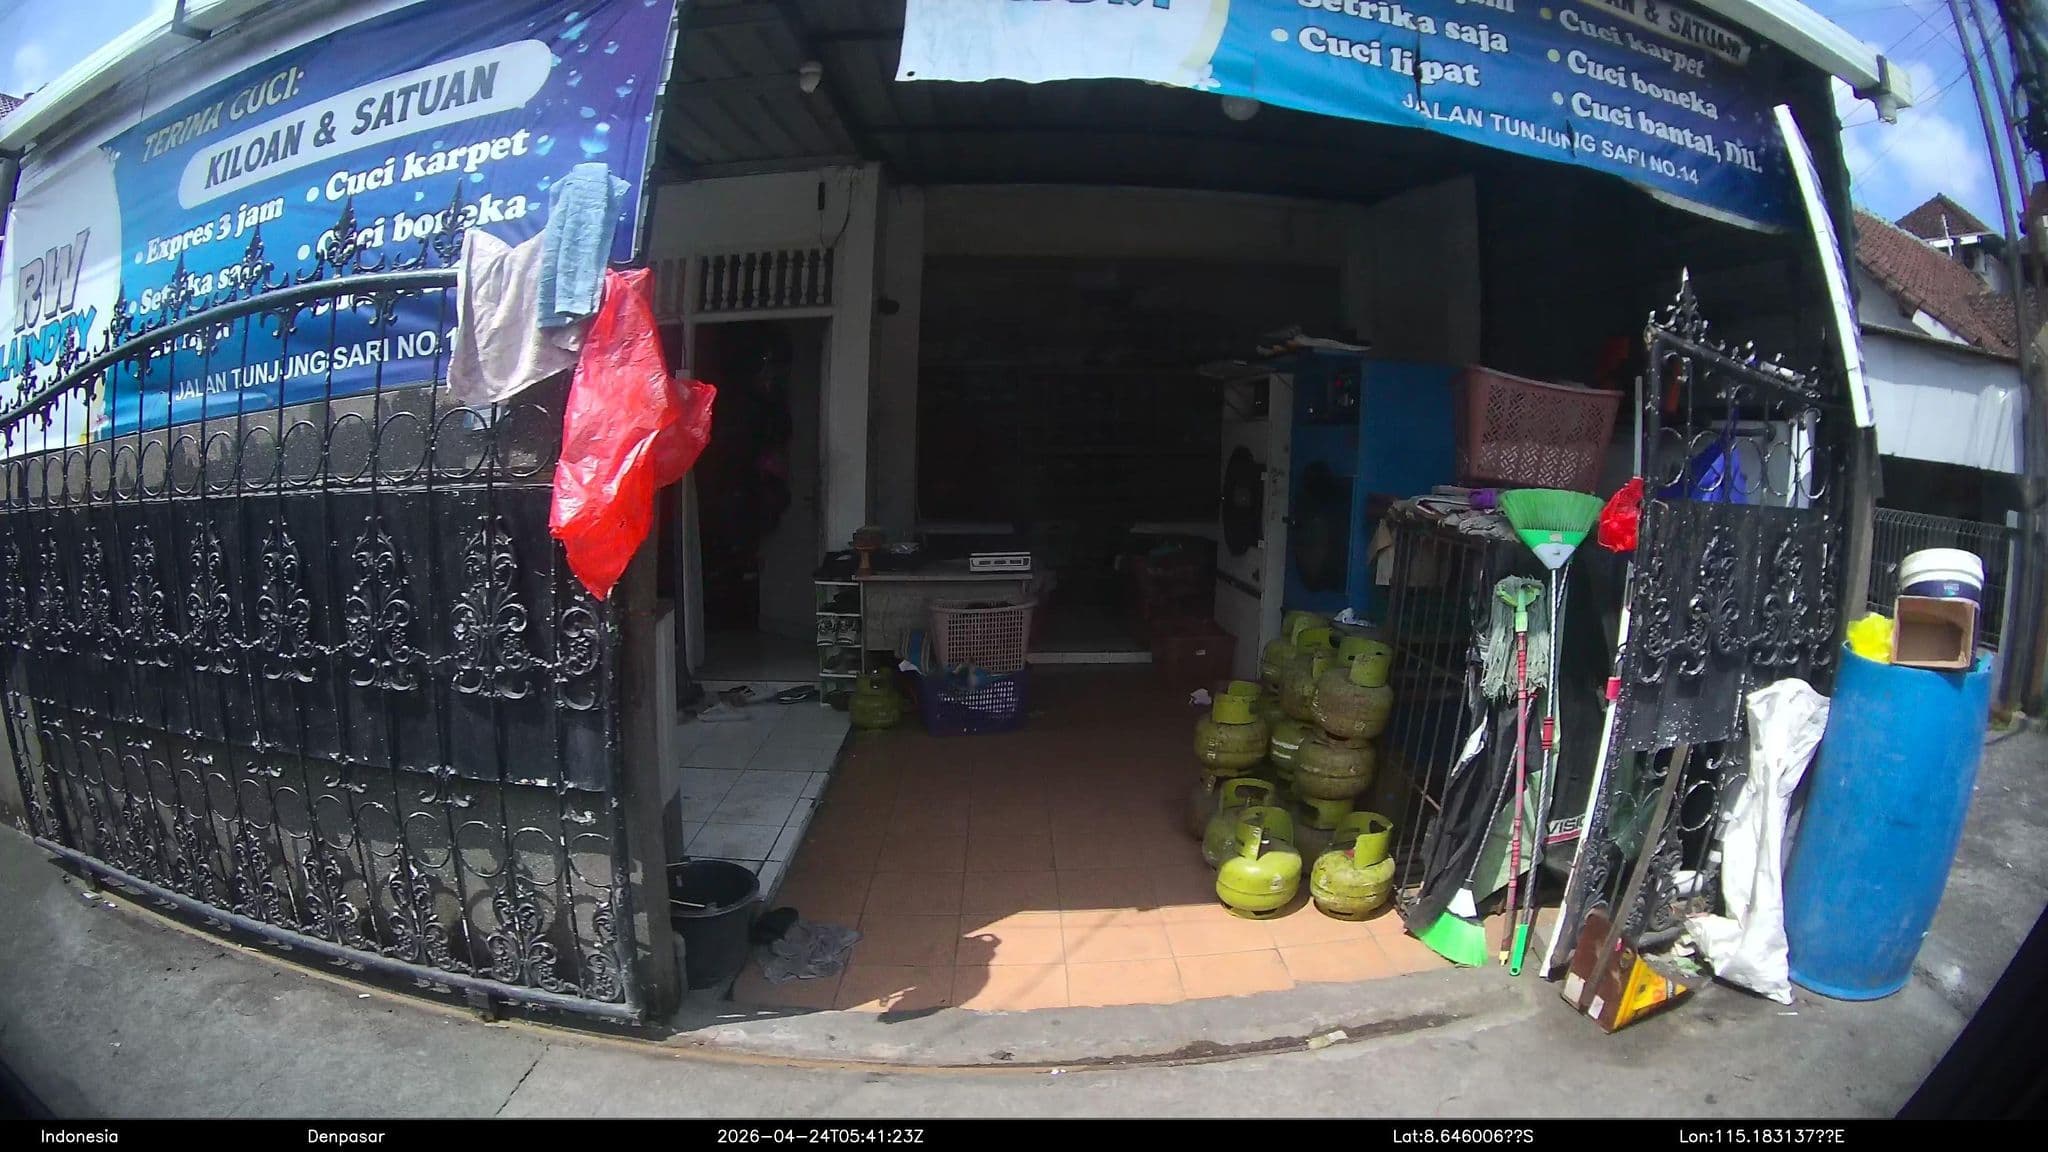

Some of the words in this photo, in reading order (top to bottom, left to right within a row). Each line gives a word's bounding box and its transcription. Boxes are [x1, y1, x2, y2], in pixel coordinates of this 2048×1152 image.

[1298, 26, 1383, 67] Cuci
[1389, 47, 1481, 87] lipat
[1445, 21, 1509, 52] saja
[1559, 8, 1625, 47] Cuci
[1625, 32, 1706, 79] karpet
[143, 101, 224, 163] TERIMA
[229, 66, 305, 121] CUCI:
[1567, 49, 1629, 88] Cuci
[1631, 71, 1719, 120] boneka
[203, 119, 306, 190] KILOAN
[313, 110, 336, 147] &
[351, 61, 500, 136] SATUAN
[1402, 93, 1483, 127] JALAN
[1490, 113, 1596, 152] TUNJUNG
[1651, 155, 1699, 184] NO.14
[1571, 91, 1635, 130] Cuci
[1638, 110, 1721, 164] bantal,
[325, 157, 396, 201] Cuci
[400, 128, 531, 182] karpet
[145, 220, 214, 264] Expres
[217, 212, 231, 241] 3
[234, 197, 285, 238] jam
[316, 216, 385, 260] Cci
[14, 227, 90, 333] RW
[175, 370, 228, 400] JALAN
[333, 339, 390, 370] SARI
